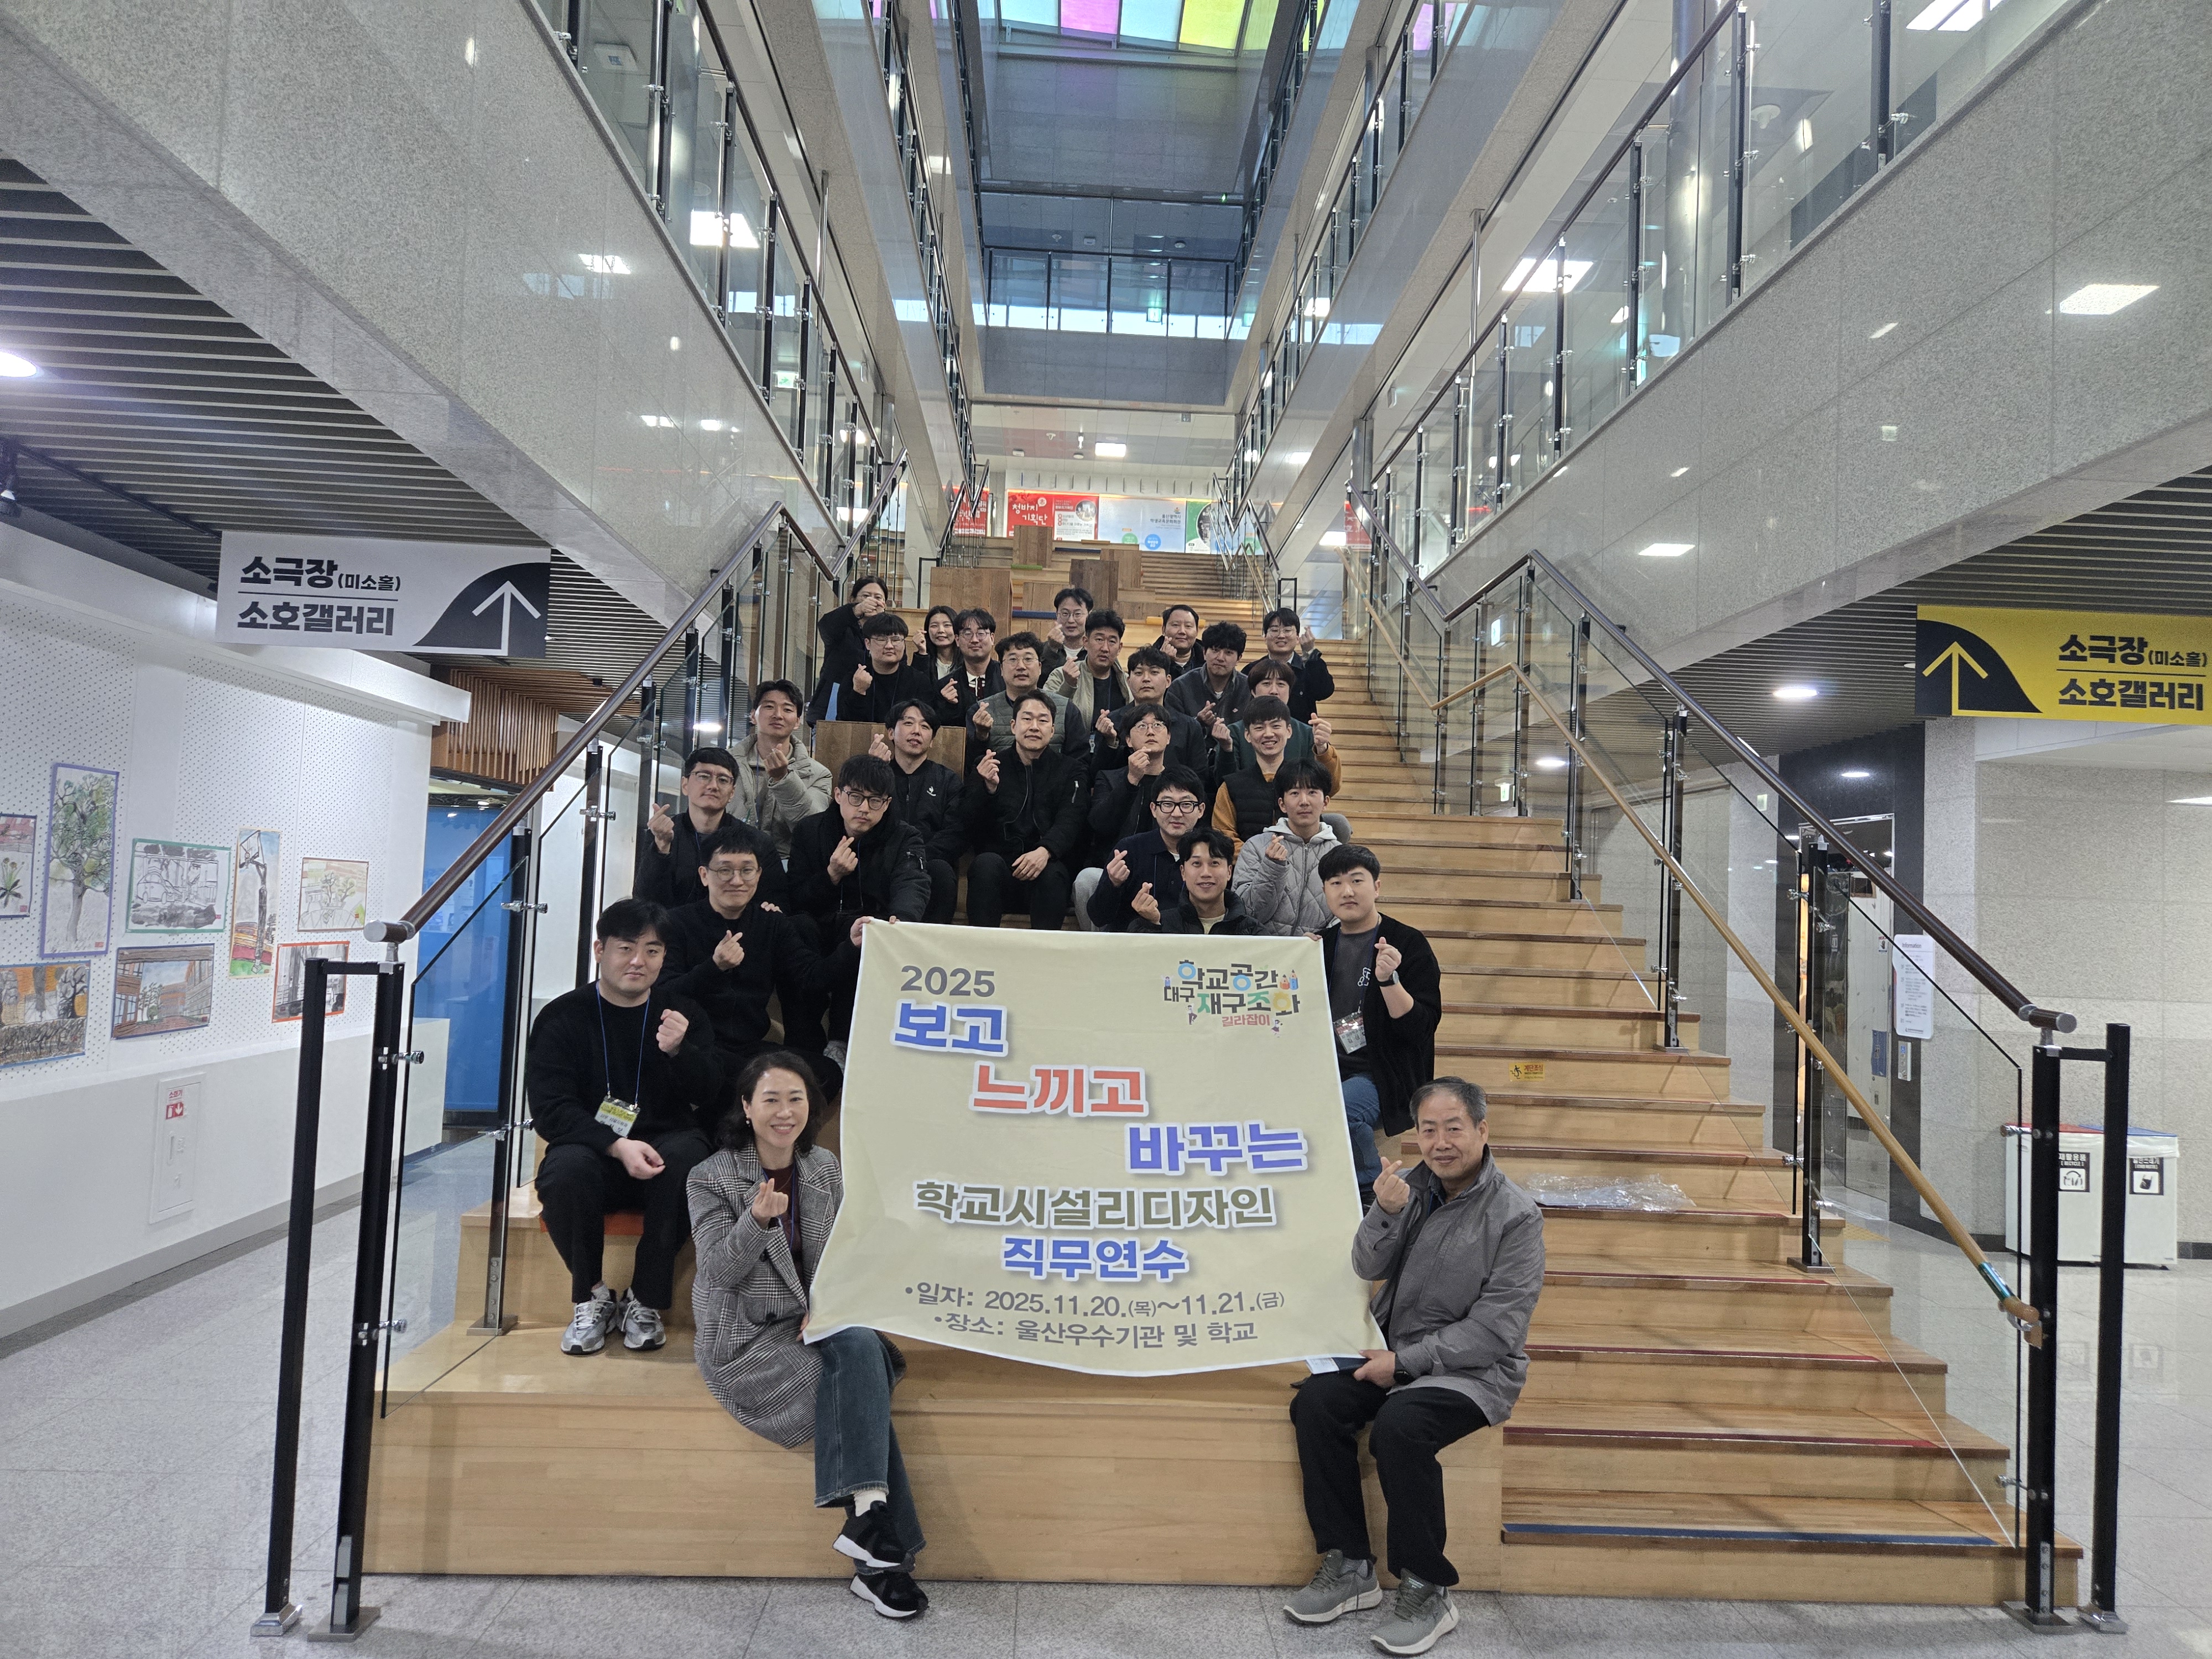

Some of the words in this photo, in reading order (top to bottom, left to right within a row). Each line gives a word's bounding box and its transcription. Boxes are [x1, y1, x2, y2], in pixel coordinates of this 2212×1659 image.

[1012, 503, 1038, 514] 청바지
[1022, 513, 1048, 525] 기획단
[237, 602, 394, 636] 소호갤러리
[2058, 679, 2204, 711] 소호갤러리
[900, 965, 995, 997] 2025
[1178, 959, 1279, 991] 학교공간
[1164, 987, 1195, 1002] 대구
[1197, 990, 1301, 1016] 재구조화
[894, 1002, 1004, 1053] 보고
[1222, 1013, 1270, 1027] 길라잡이
[169, 1089, 182, 1098] 소화기
[973, 1064, 1145, 1113] 느끼고
[1128, 1123, 1303, 1172] 바꾸는
[915, 1181, 1274, 1227] 학교시설리디자인
[1003, 1237, 1186, 1279] 직무연수
[1015, 1319, 1165, 1349] 울산우수기관
[1173, 1323, 1198, 1347] 및
[1207, 1321, 1259, 1344] 학교
